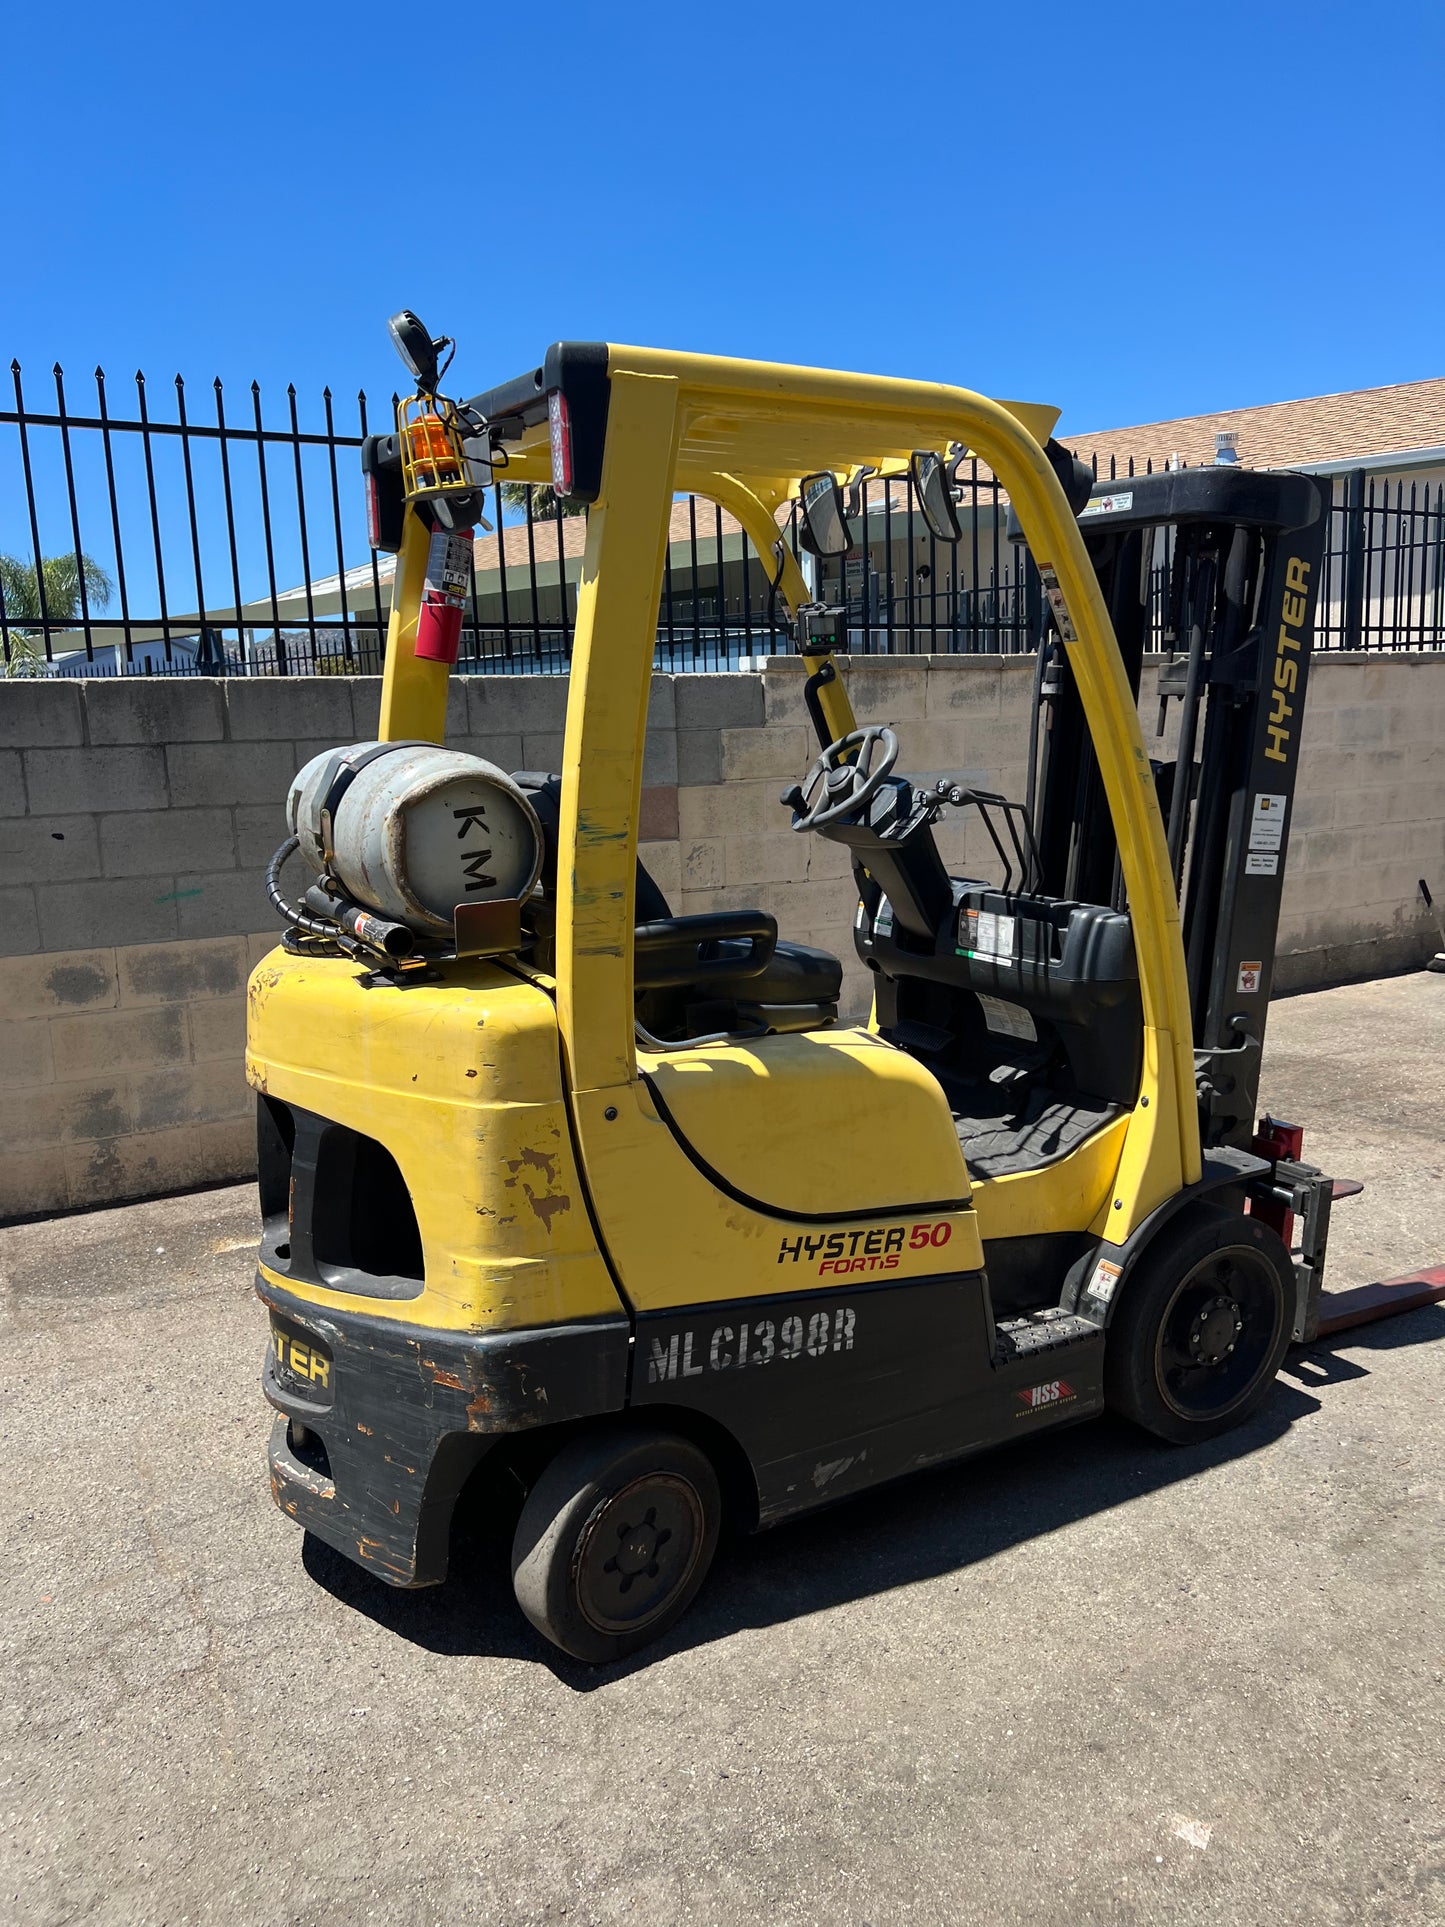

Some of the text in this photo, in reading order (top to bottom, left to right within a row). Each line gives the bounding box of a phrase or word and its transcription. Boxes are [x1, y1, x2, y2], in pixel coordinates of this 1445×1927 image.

[1265, 556, 1311, 763] HYSTER
[778, 1222, 952, 1264] HYSTER 50
[818, 1254, 901, 1276] FORTIS
[274, 1329, 330, 1389] TER
[1031, 1381, 1060, 1407] HSS
